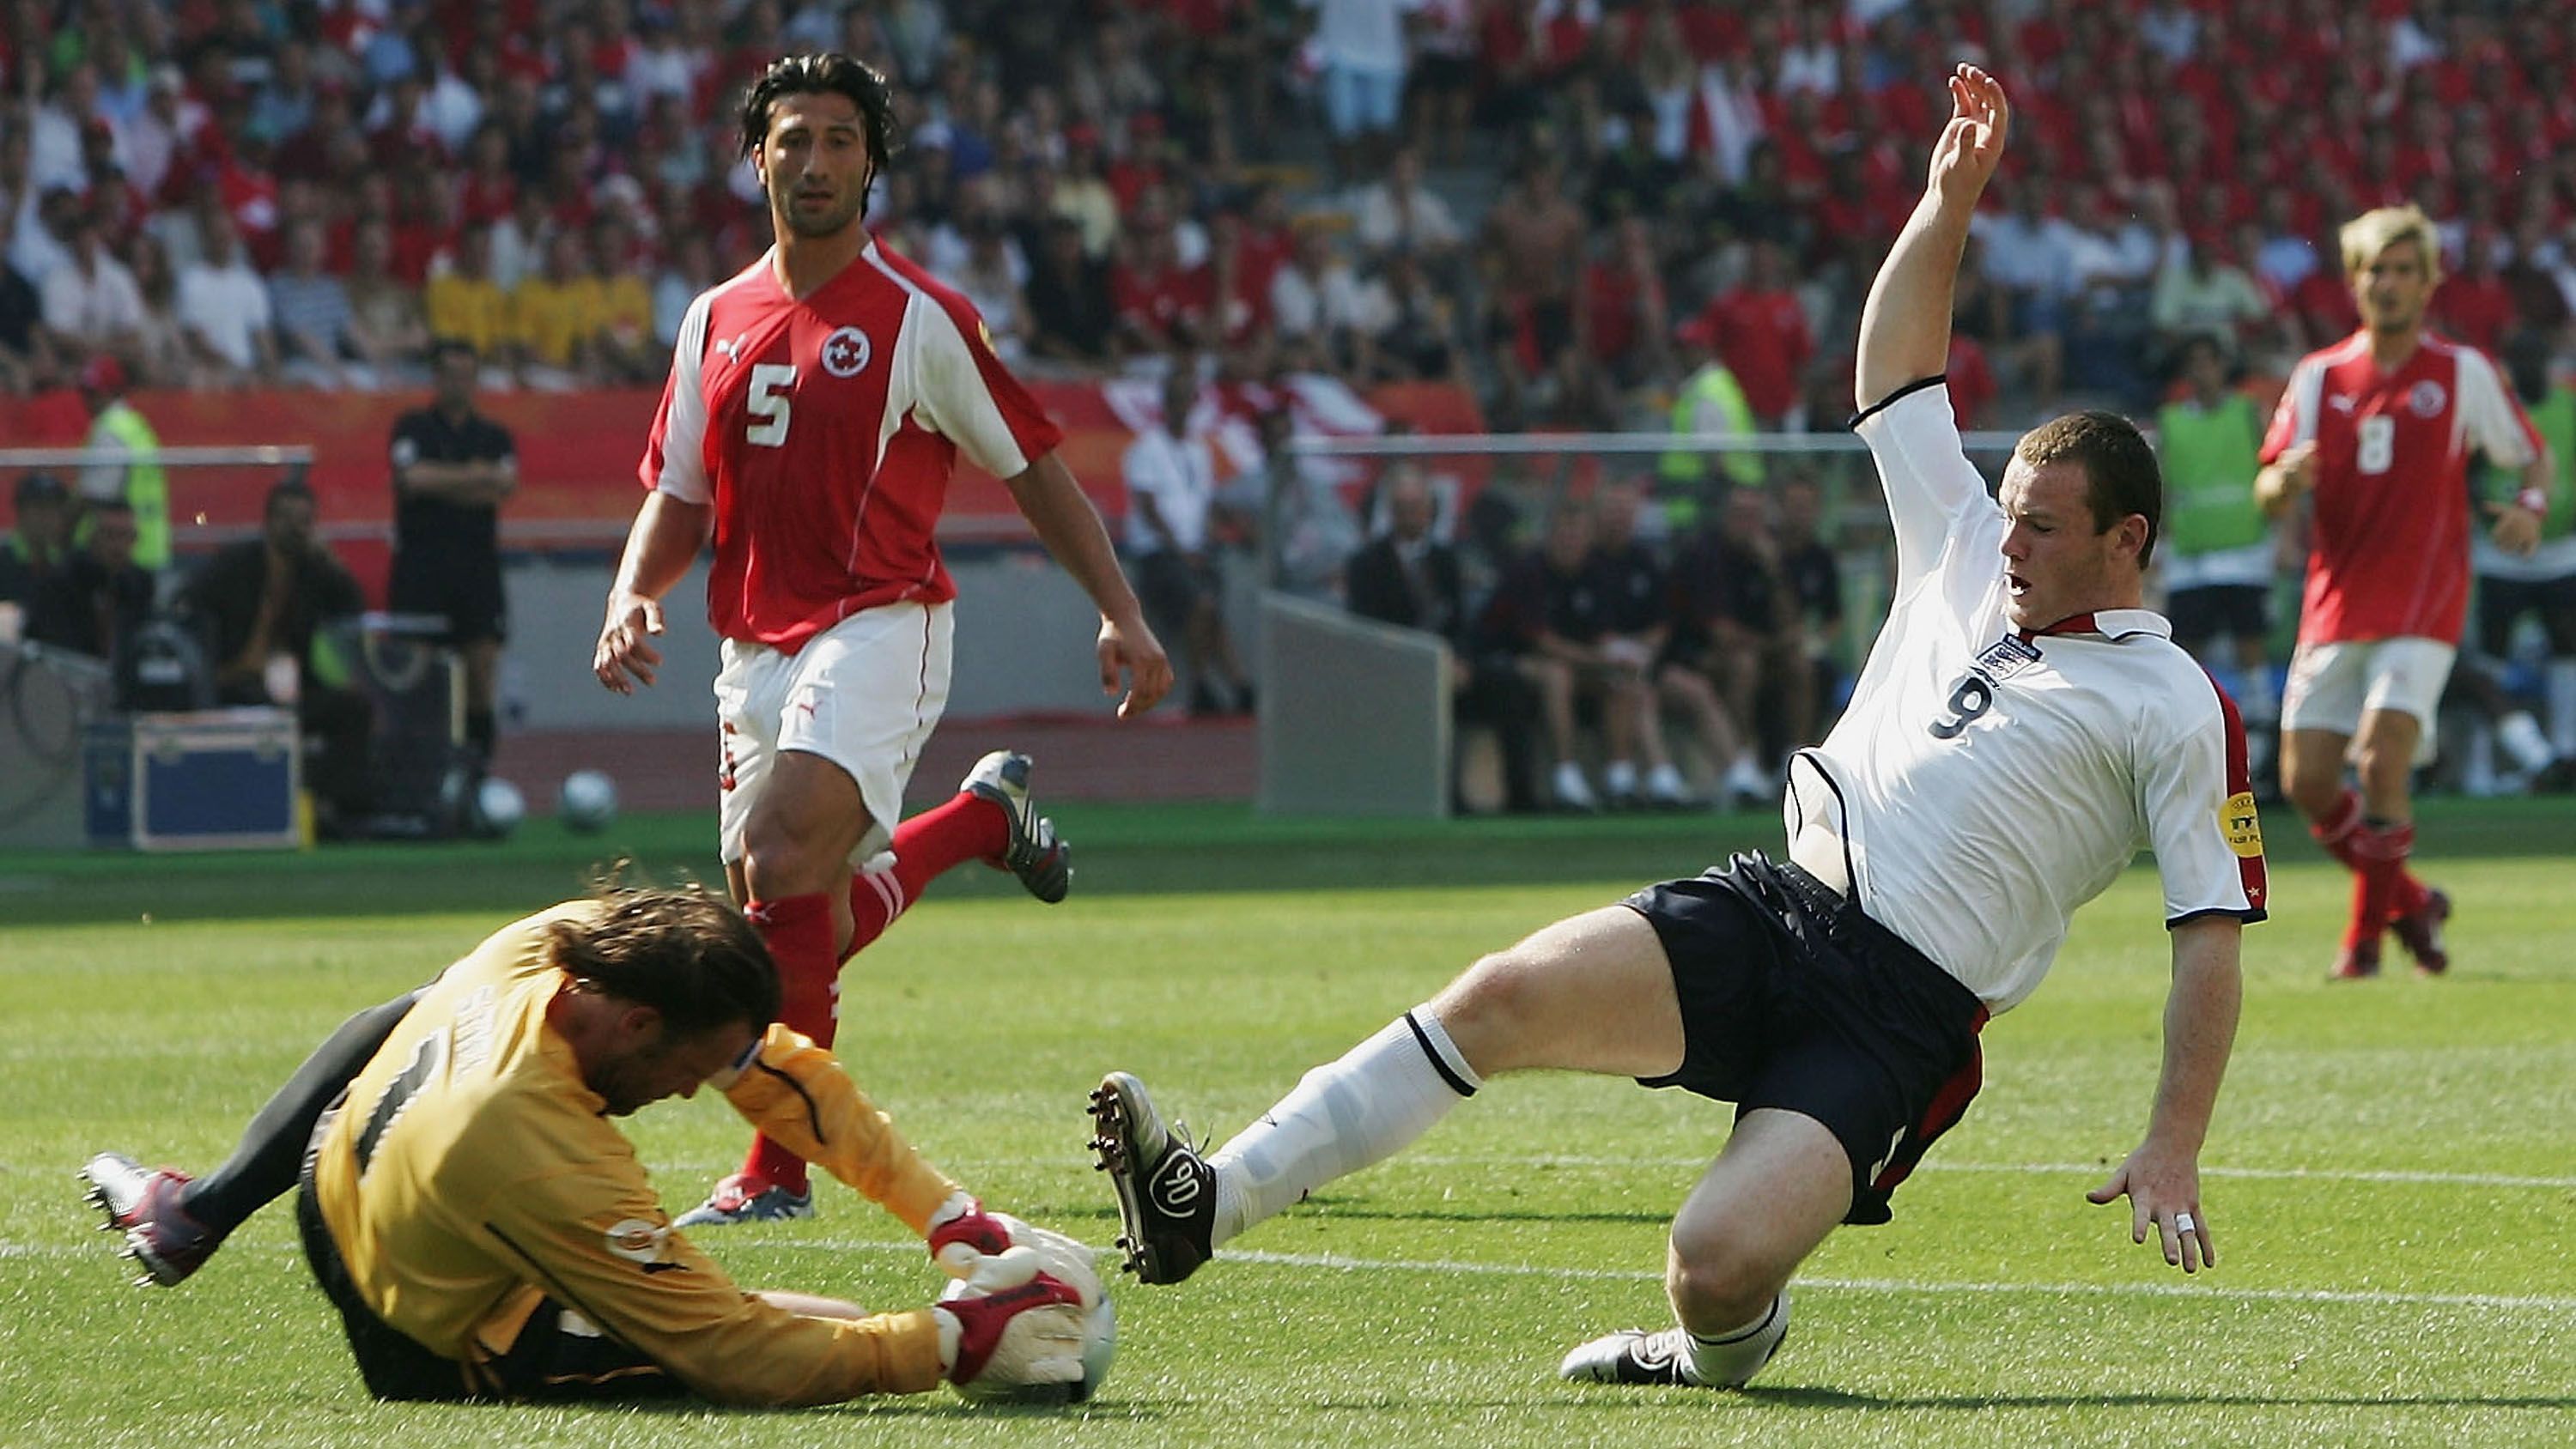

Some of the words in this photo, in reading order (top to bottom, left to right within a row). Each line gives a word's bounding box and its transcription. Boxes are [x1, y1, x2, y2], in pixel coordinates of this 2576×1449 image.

[747, 364, 797, 447] 5
[2357, 415, 2395, 475] 8
[1928, 677, 1992, 739] 9
[1165, 1161, 1200, 1204] 90
